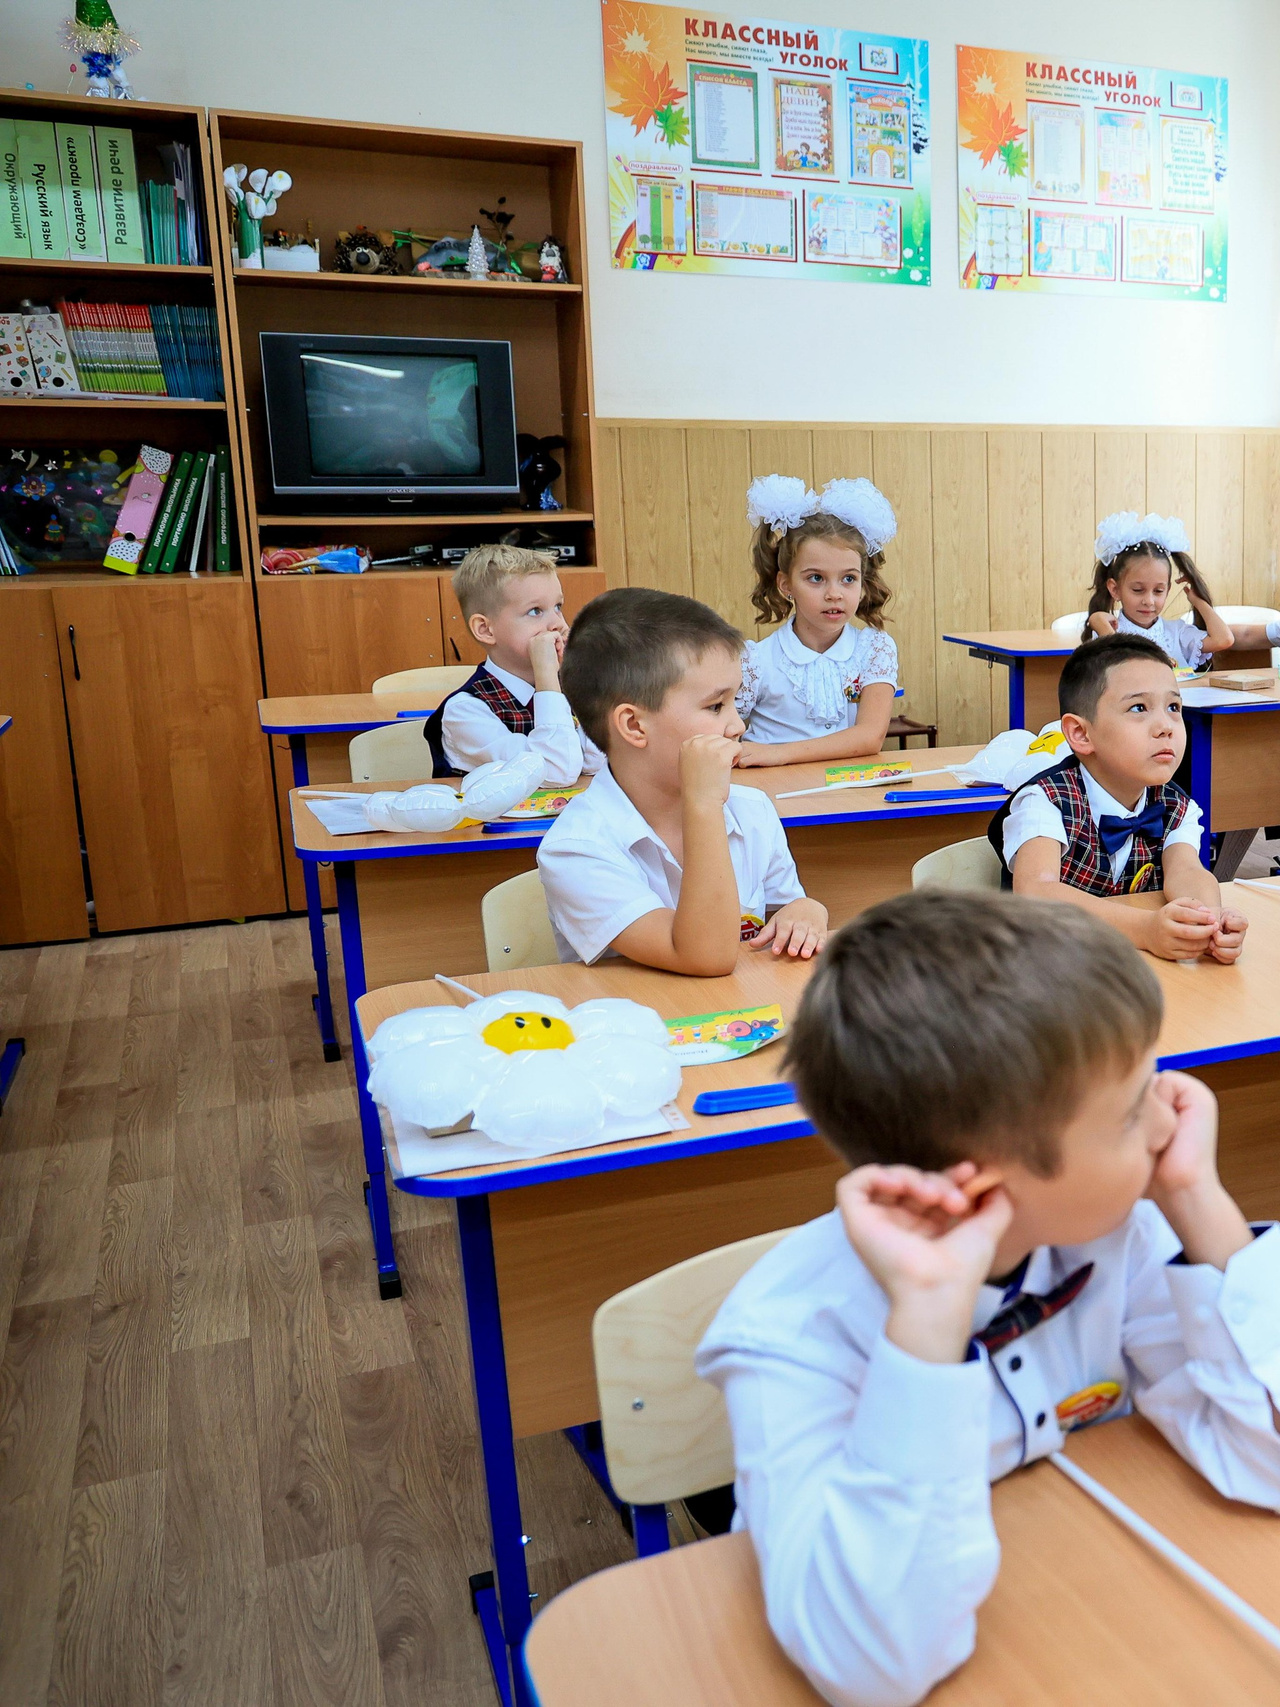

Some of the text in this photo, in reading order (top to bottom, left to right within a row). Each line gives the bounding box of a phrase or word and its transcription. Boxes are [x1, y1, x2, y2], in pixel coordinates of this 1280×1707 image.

[685, 17, 819, 51] КЛАССНЫЙ
[779, 51, 849, 71] УГОЛОК
[1026, 62, 1137, 90] КЛАССНЫЙ
[1104, 91, 1162, 108] УГОЛОК
[4, 152, 27, 239] Окружающий
[31, 163, 54, 250] Русский язык
[66, 137, 87, 250] «Создаем проект»
[108, 139, 128, 245] Развитие речи
[153, 478, 182, 547] ПОРТФОЛИО ШКОЛЬНИКА
[171, 477, 198, 547] ПОРТФОЛИО ШКОЛЬНИКА
